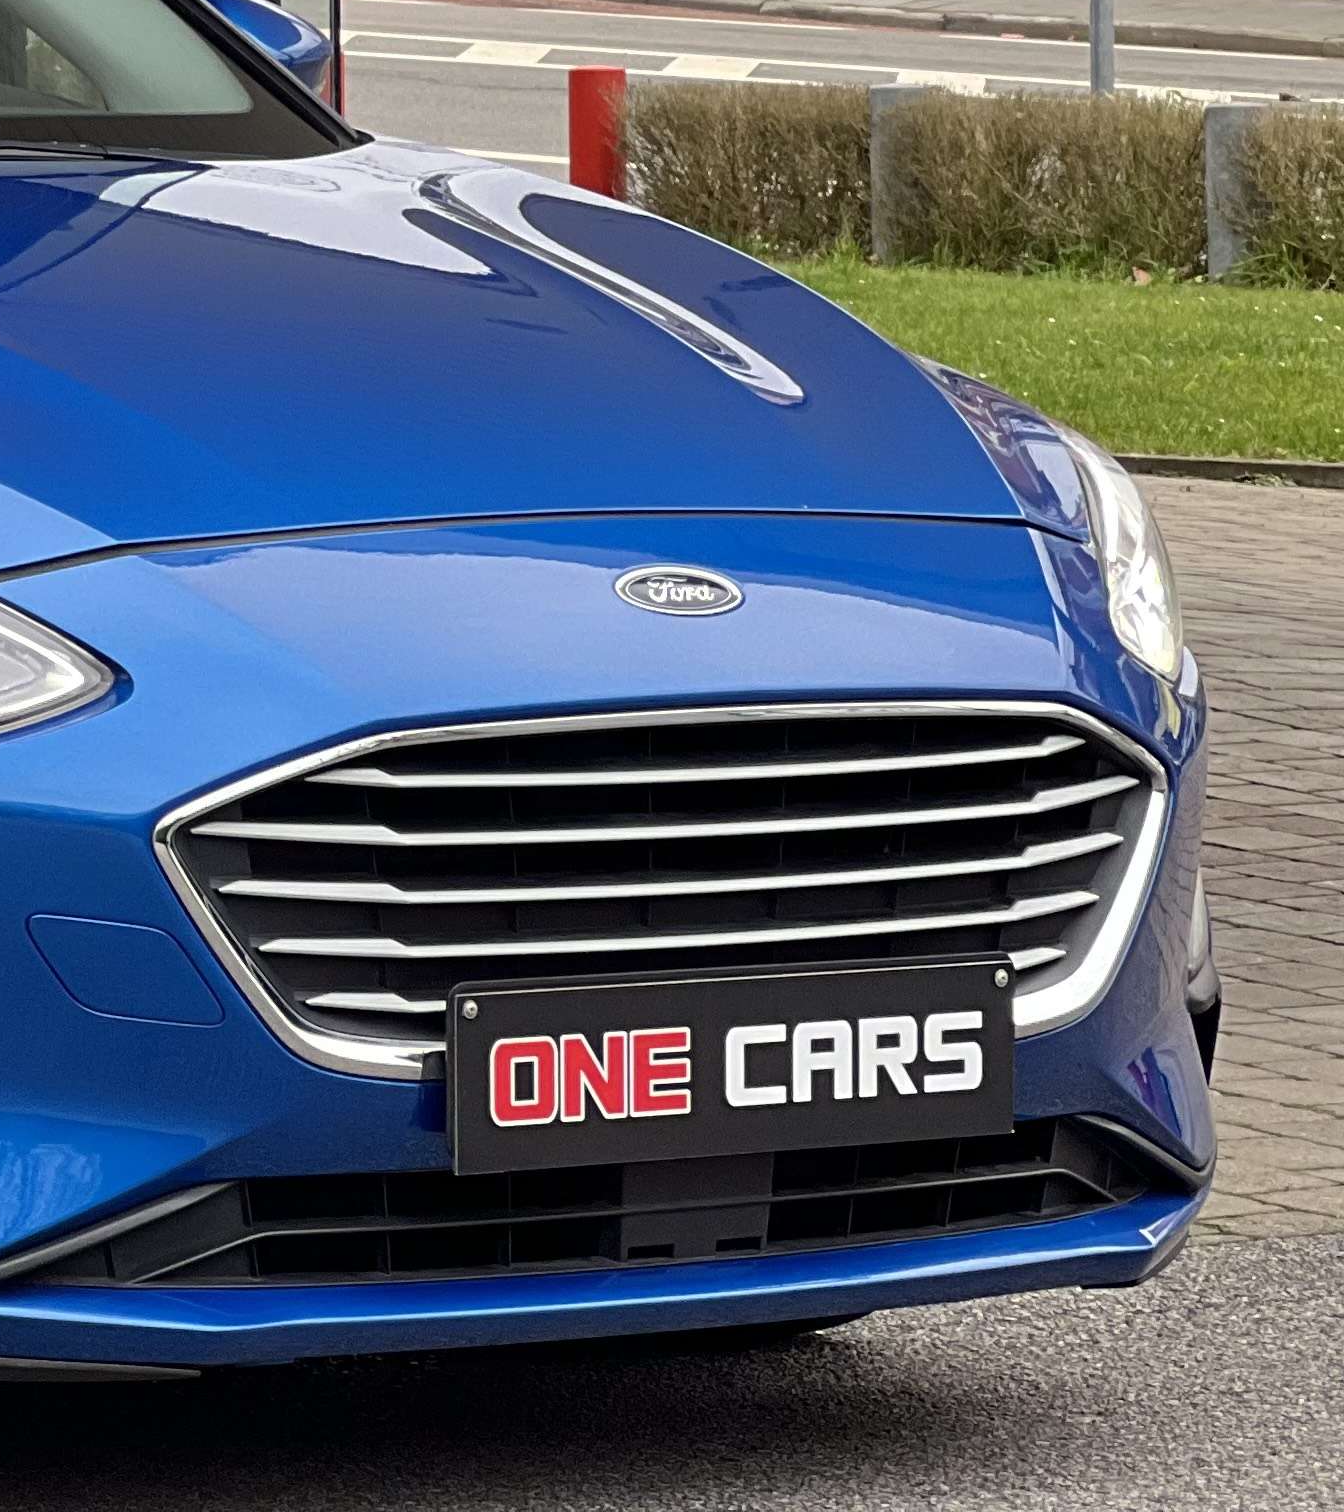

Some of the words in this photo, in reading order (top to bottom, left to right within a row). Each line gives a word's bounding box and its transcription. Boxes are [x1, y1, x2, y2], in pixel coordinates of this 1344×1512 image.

[647, 576, 715, 603] Ford
[490, 1026, 691, 1127] ONE
[725, 1010, 983, 1107] CARS
